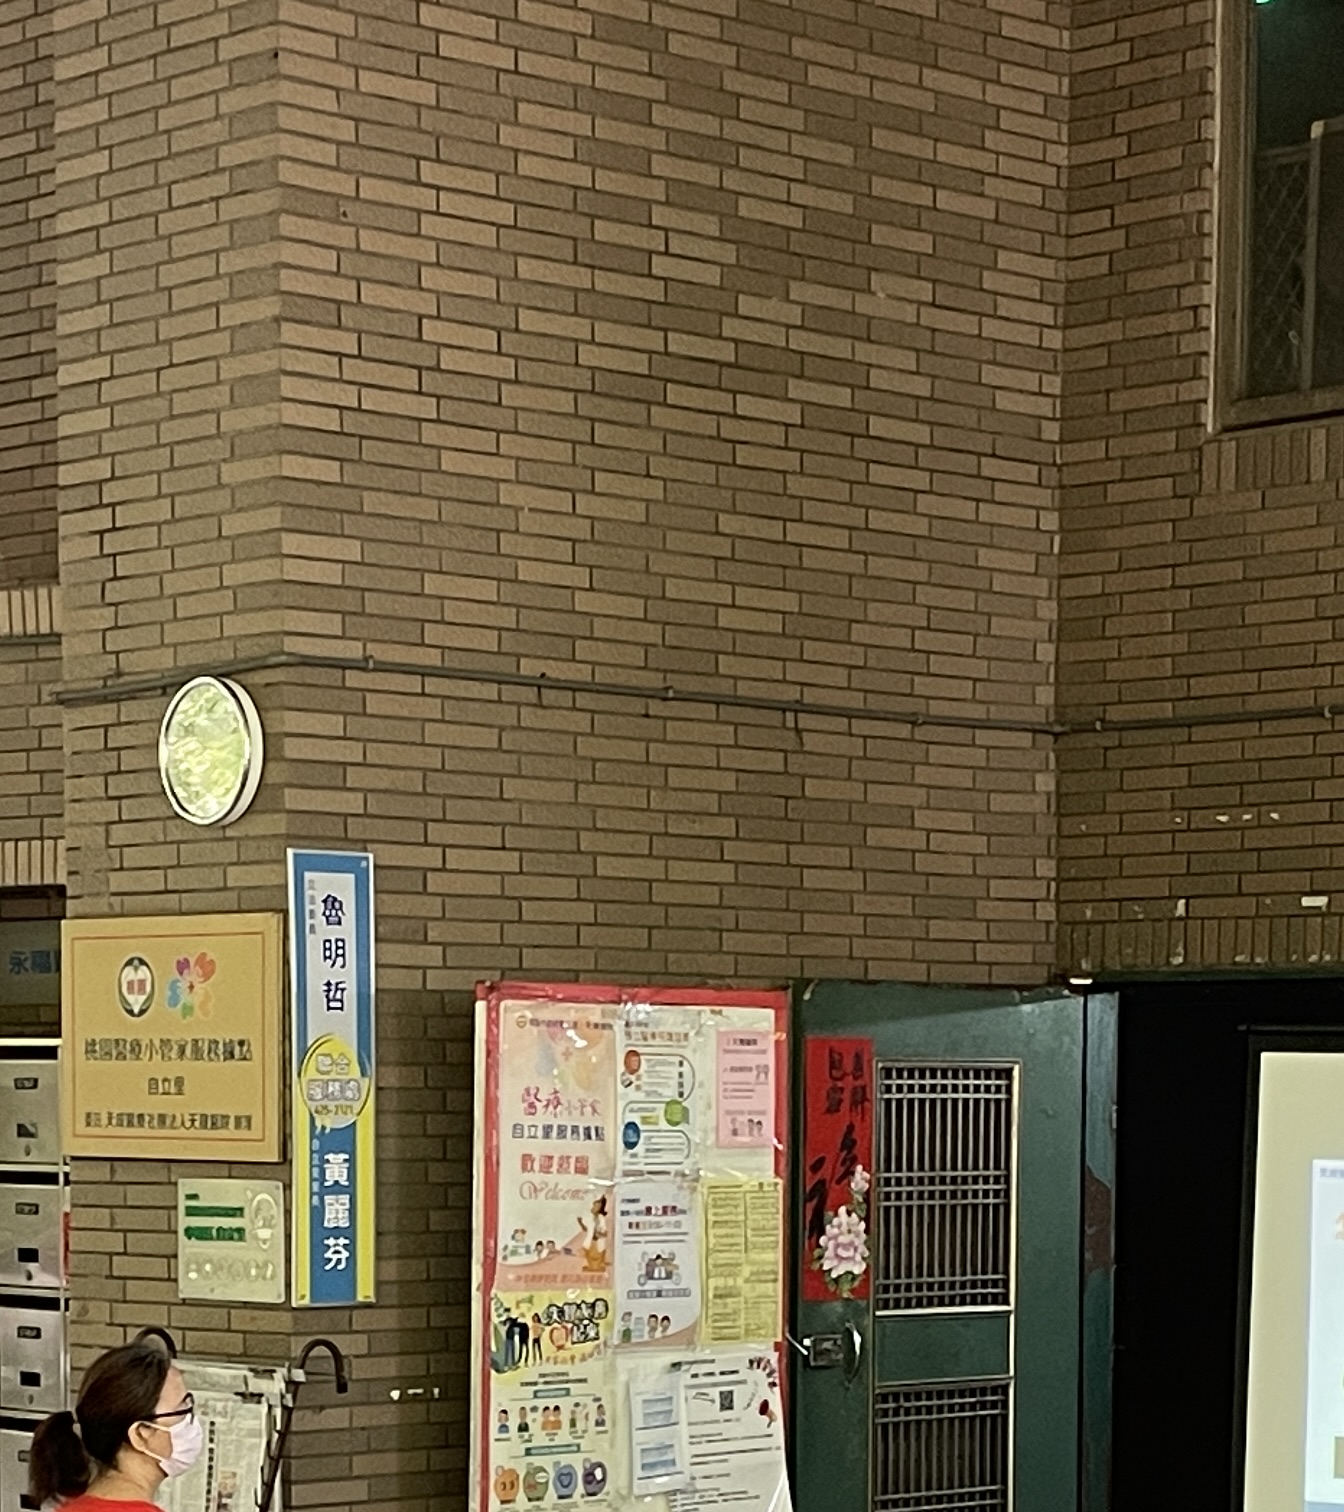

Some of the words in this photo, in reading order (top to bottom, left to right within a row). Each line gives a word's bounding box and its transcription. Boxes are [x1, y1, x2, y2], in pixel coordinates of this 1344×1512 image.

[320, 893, 347, 1012] 魯明哲
[147, 1075, 186, 1097] 自立里
[322, 1152, 351, 1271] 黃麗芬
